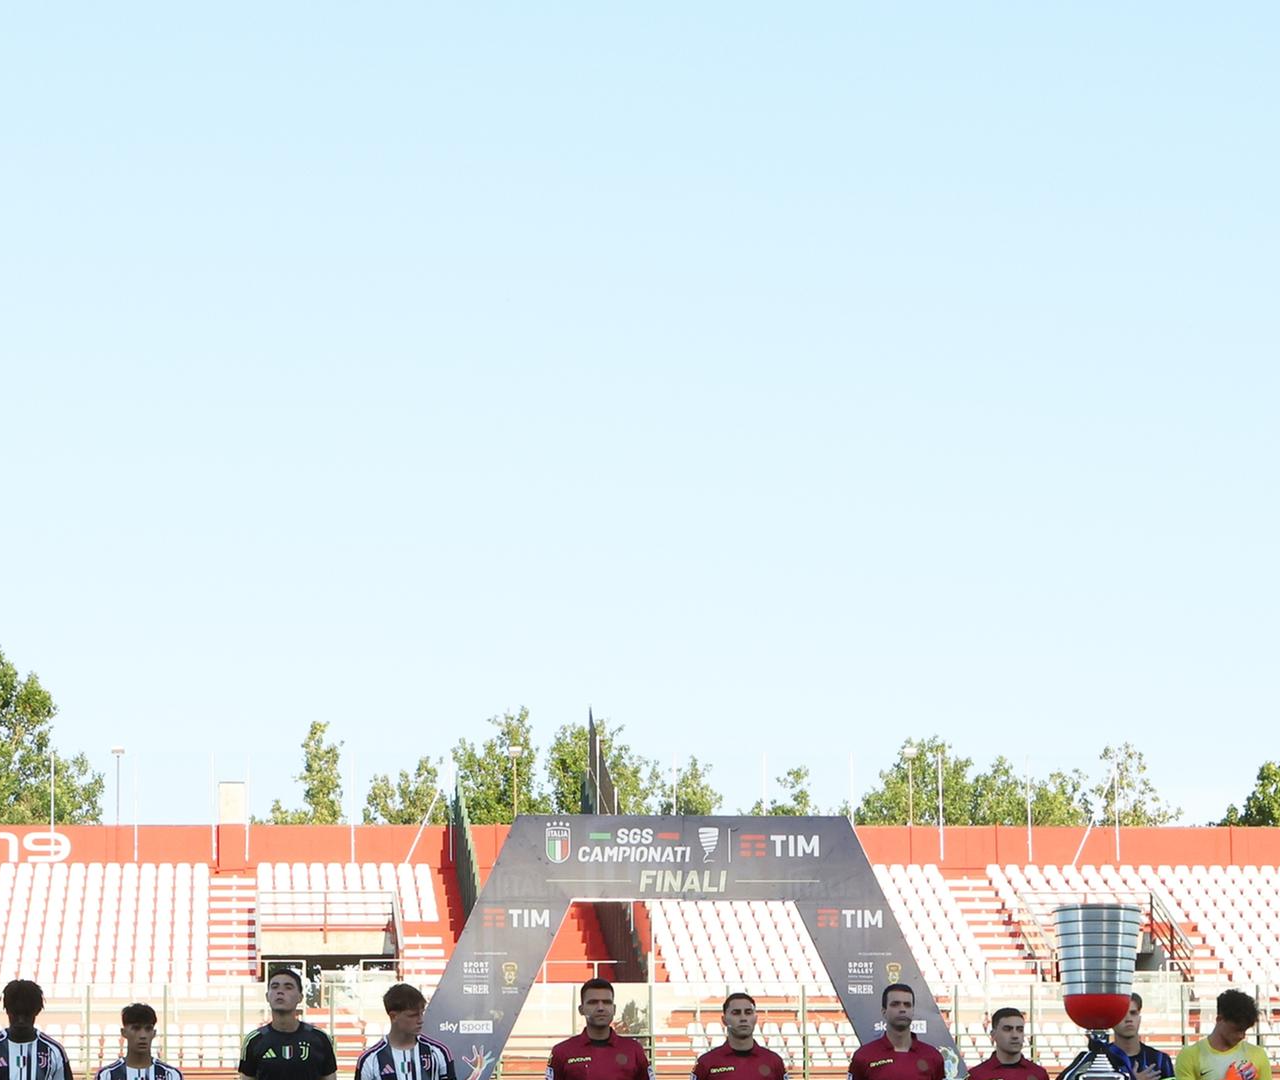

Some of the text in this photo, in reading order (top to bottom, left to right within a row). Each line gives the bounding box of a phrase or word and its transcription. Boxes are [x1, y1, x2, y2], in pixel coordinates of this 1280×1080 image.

[615, 828, 653, 844] SGS
[577, 846, 690, 862] CAMPIONATI
[769, 835, 819, 857] TIM
[638, 870, 727, 893] FINALI
[508, 909, 550, 928] TIM
[841, 909, 883, 928] TIM
[439, 1020, 492, 1033] sky sport
[873, 1020, 887, 1031] sk
[568, 1056, 592, 1064] GIVOVA
